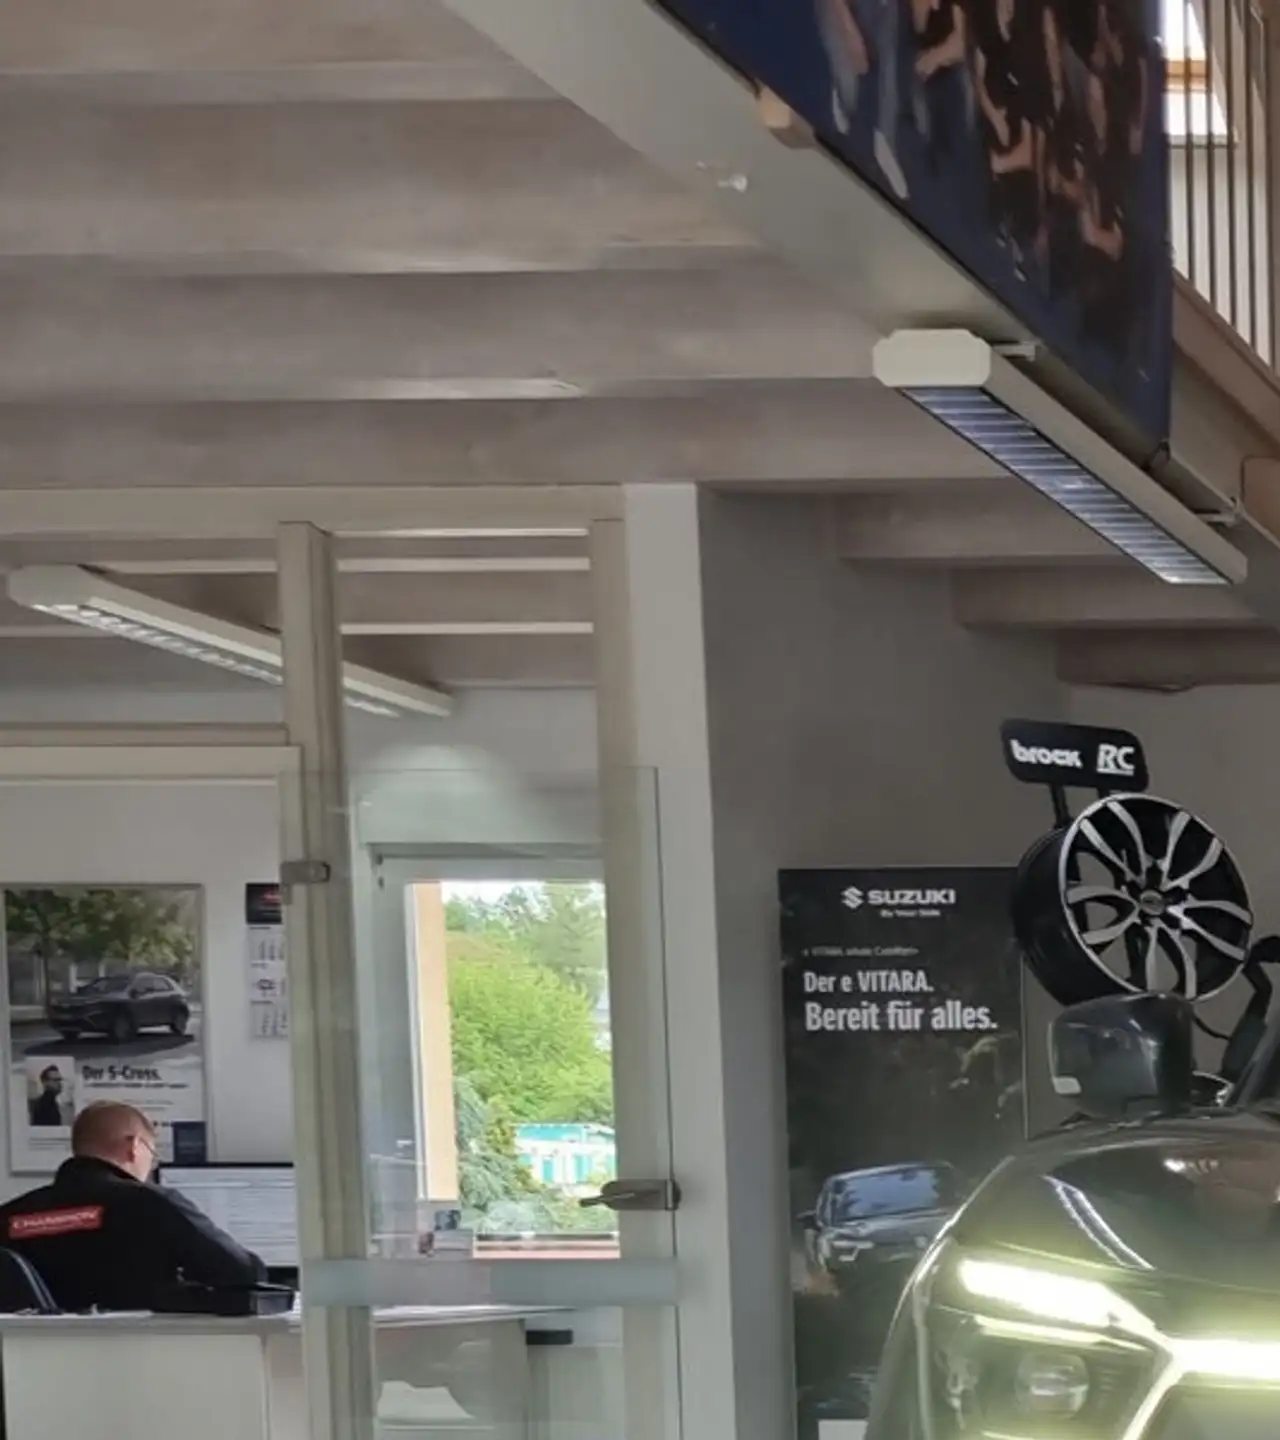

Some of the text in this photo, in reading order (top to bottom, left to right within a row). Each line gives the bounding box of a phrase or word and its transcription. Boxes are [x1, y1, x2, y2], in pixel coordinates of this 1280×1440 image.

[1010, 739, 1135, 771] brock RC
[868, 889, 956, 904] SUZUKI
[804, 970, 934, 992] Der e VITARA.
[805, 999, 998, 1031] Bereit für alles.
